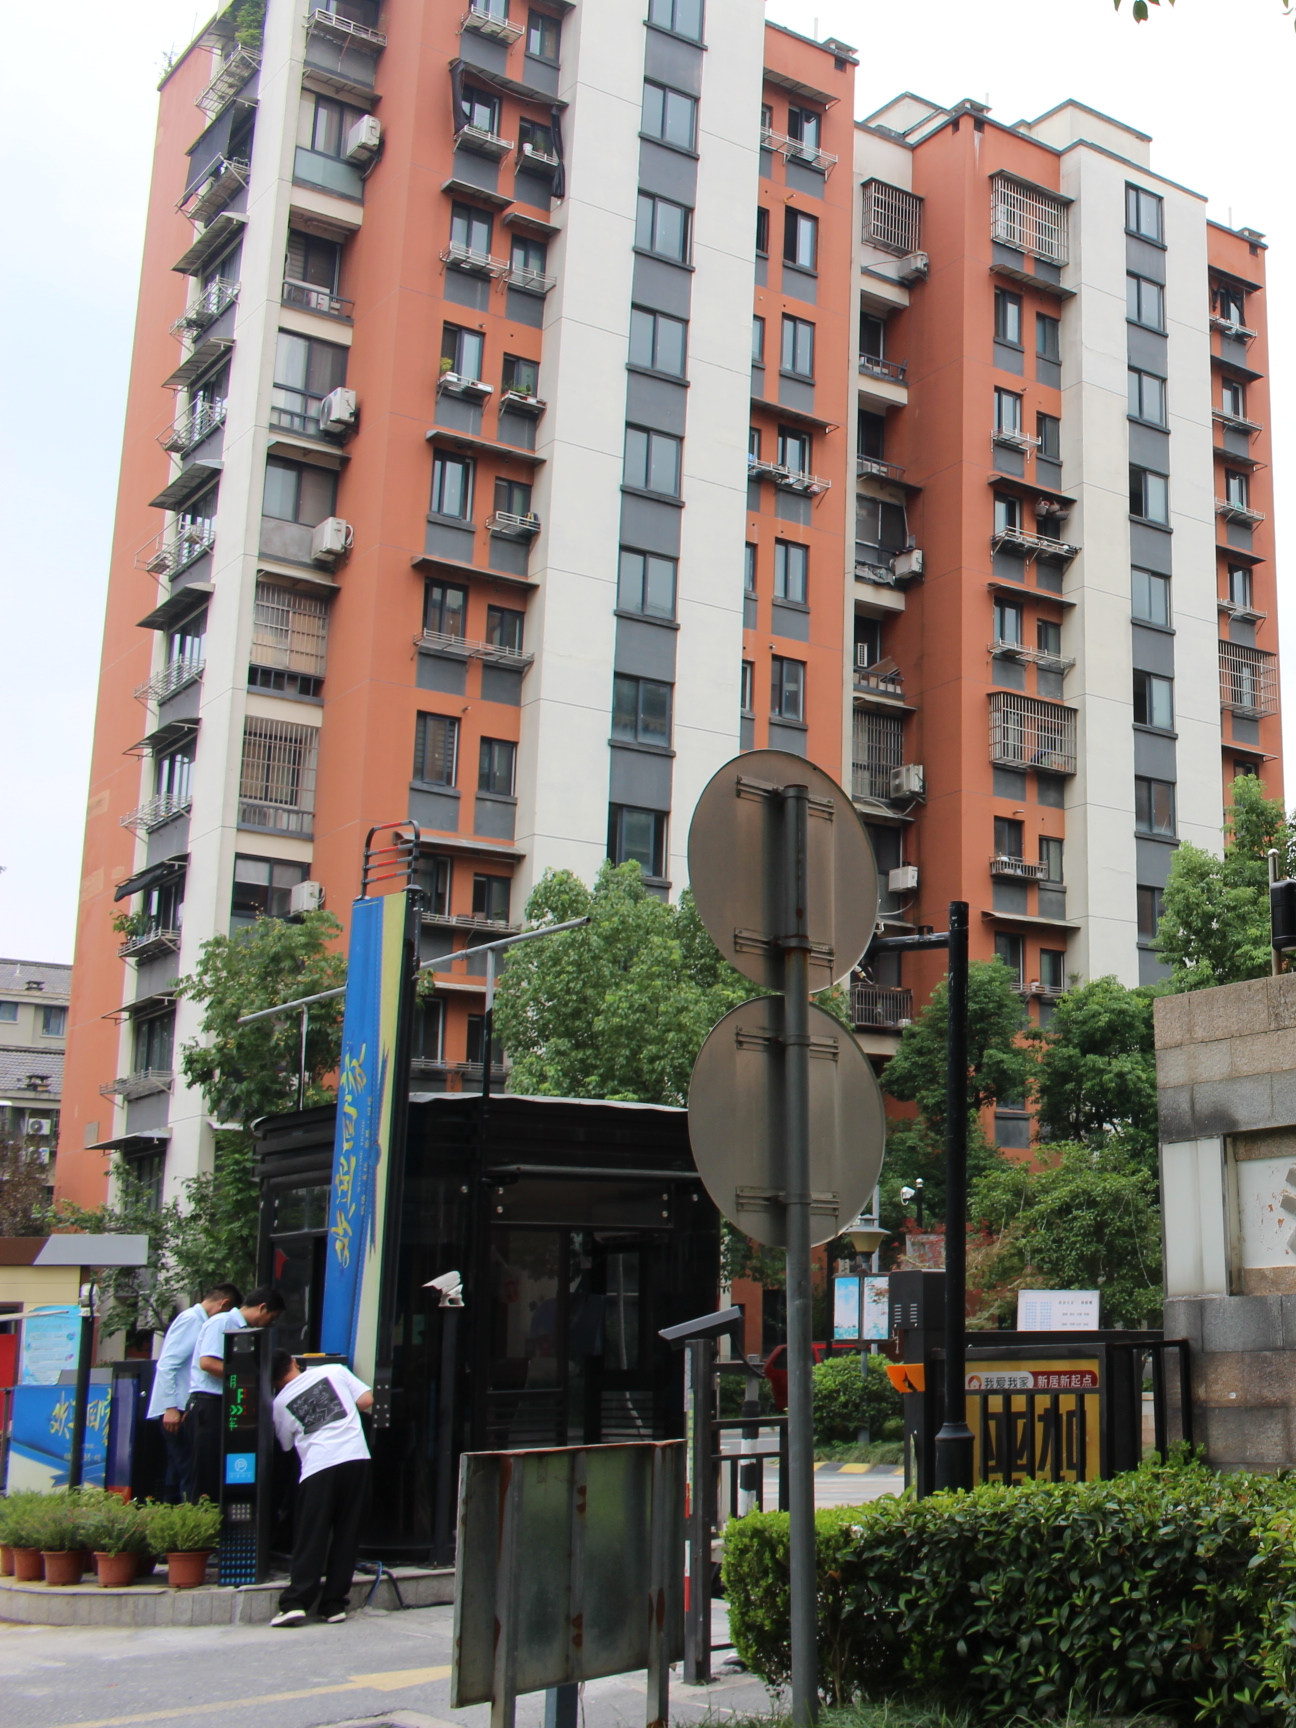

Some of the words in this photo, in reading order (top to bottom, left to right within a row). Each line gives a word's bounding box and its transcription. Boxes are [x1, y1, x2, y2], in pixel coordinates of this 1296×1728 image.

[330, 1043, 366, 1268] 欢迎回家
[984, 1376, 1029, 1389] 我爱我家
[1037, 1374, 1093, 1388] 新居新起点
[50, 1388, 112, 1446] 欢回
